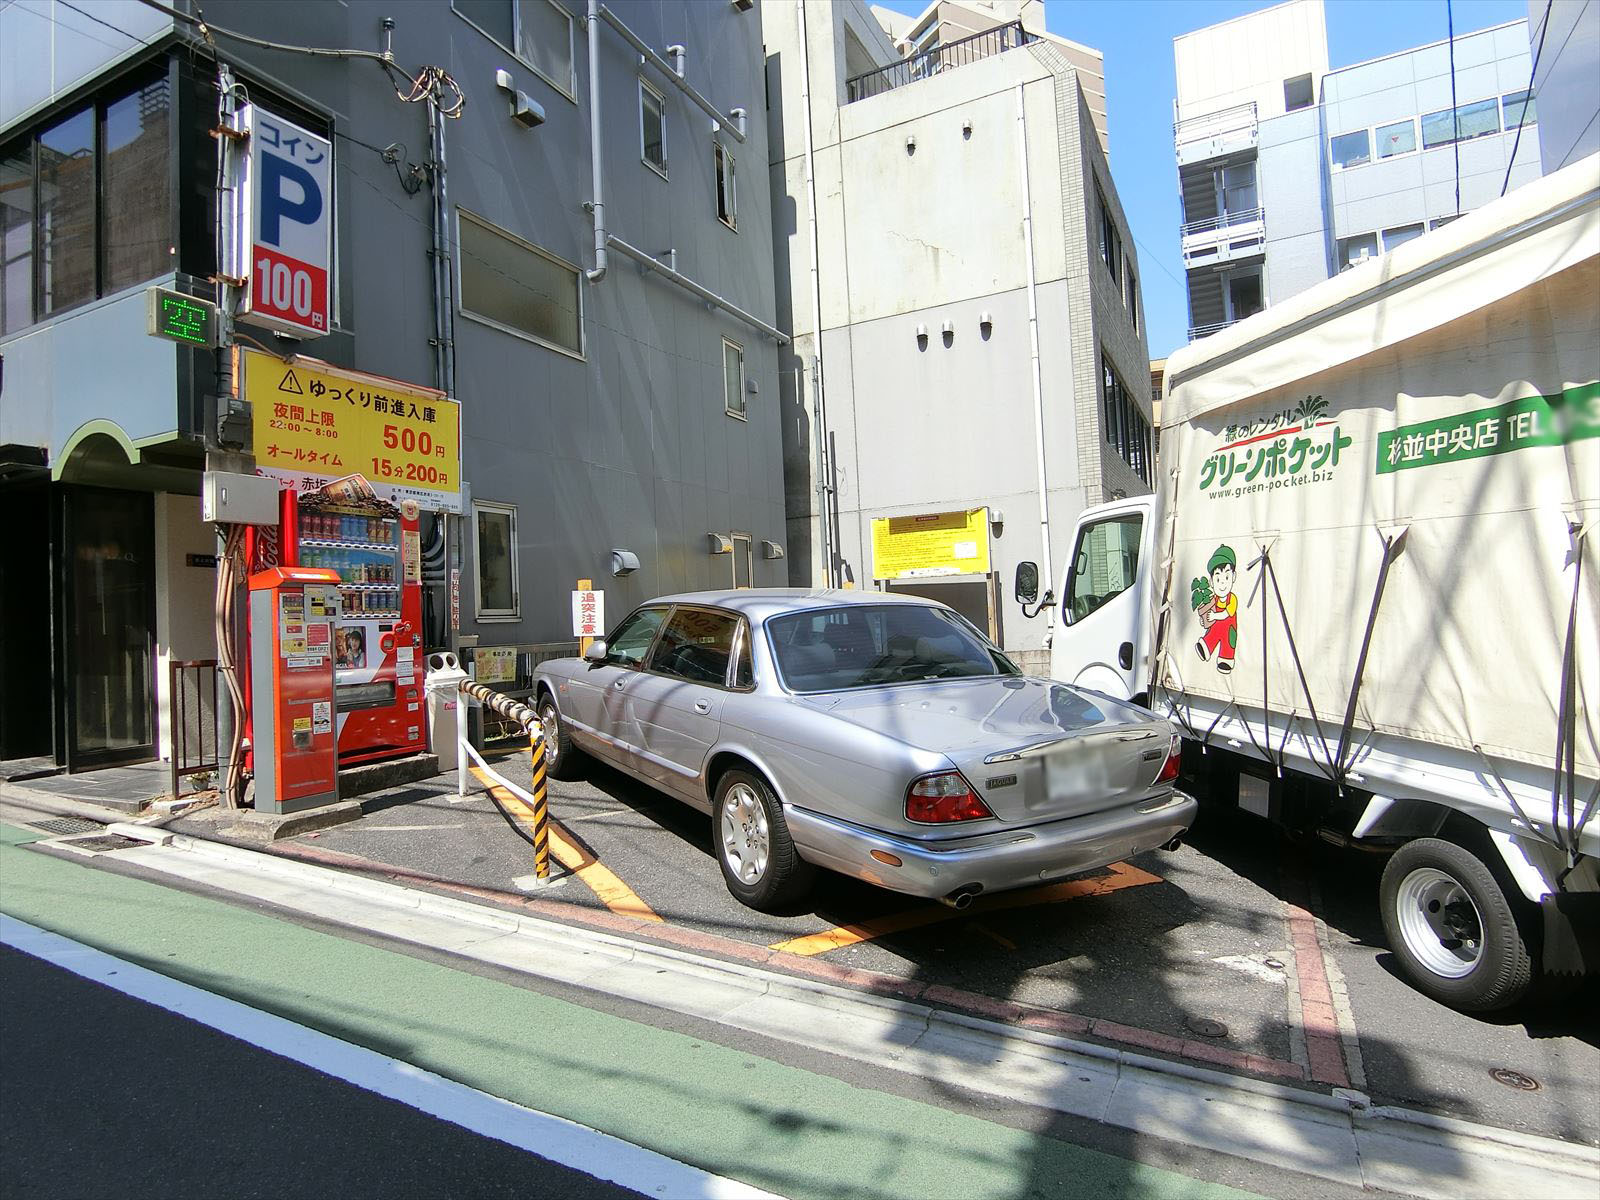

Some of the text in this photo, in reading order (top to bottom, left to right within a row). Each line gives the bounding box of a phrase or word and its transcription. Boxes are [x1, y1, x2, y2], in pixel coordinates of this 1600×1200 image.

[259, 121, 325, 165] コイン
[260, 149, 323, 248] P
[163, 298, 206, 343] 空
[273, 402, 336, 428] 夜間上限
[309, 379, 437, 424] ゆっくり前進入庫
[1224, 408, 1297, 444] 緑のレンタル
[1386, 417, 1500, 466] 杉並中央店
[266, 444, 343, 467] オールタイム
[1199, 425, 1353, 491] グリーンポケット
[1208, 469, 1334, 500] www.green-pocket.biz
[580, 592, 597, 635] 追突注意
